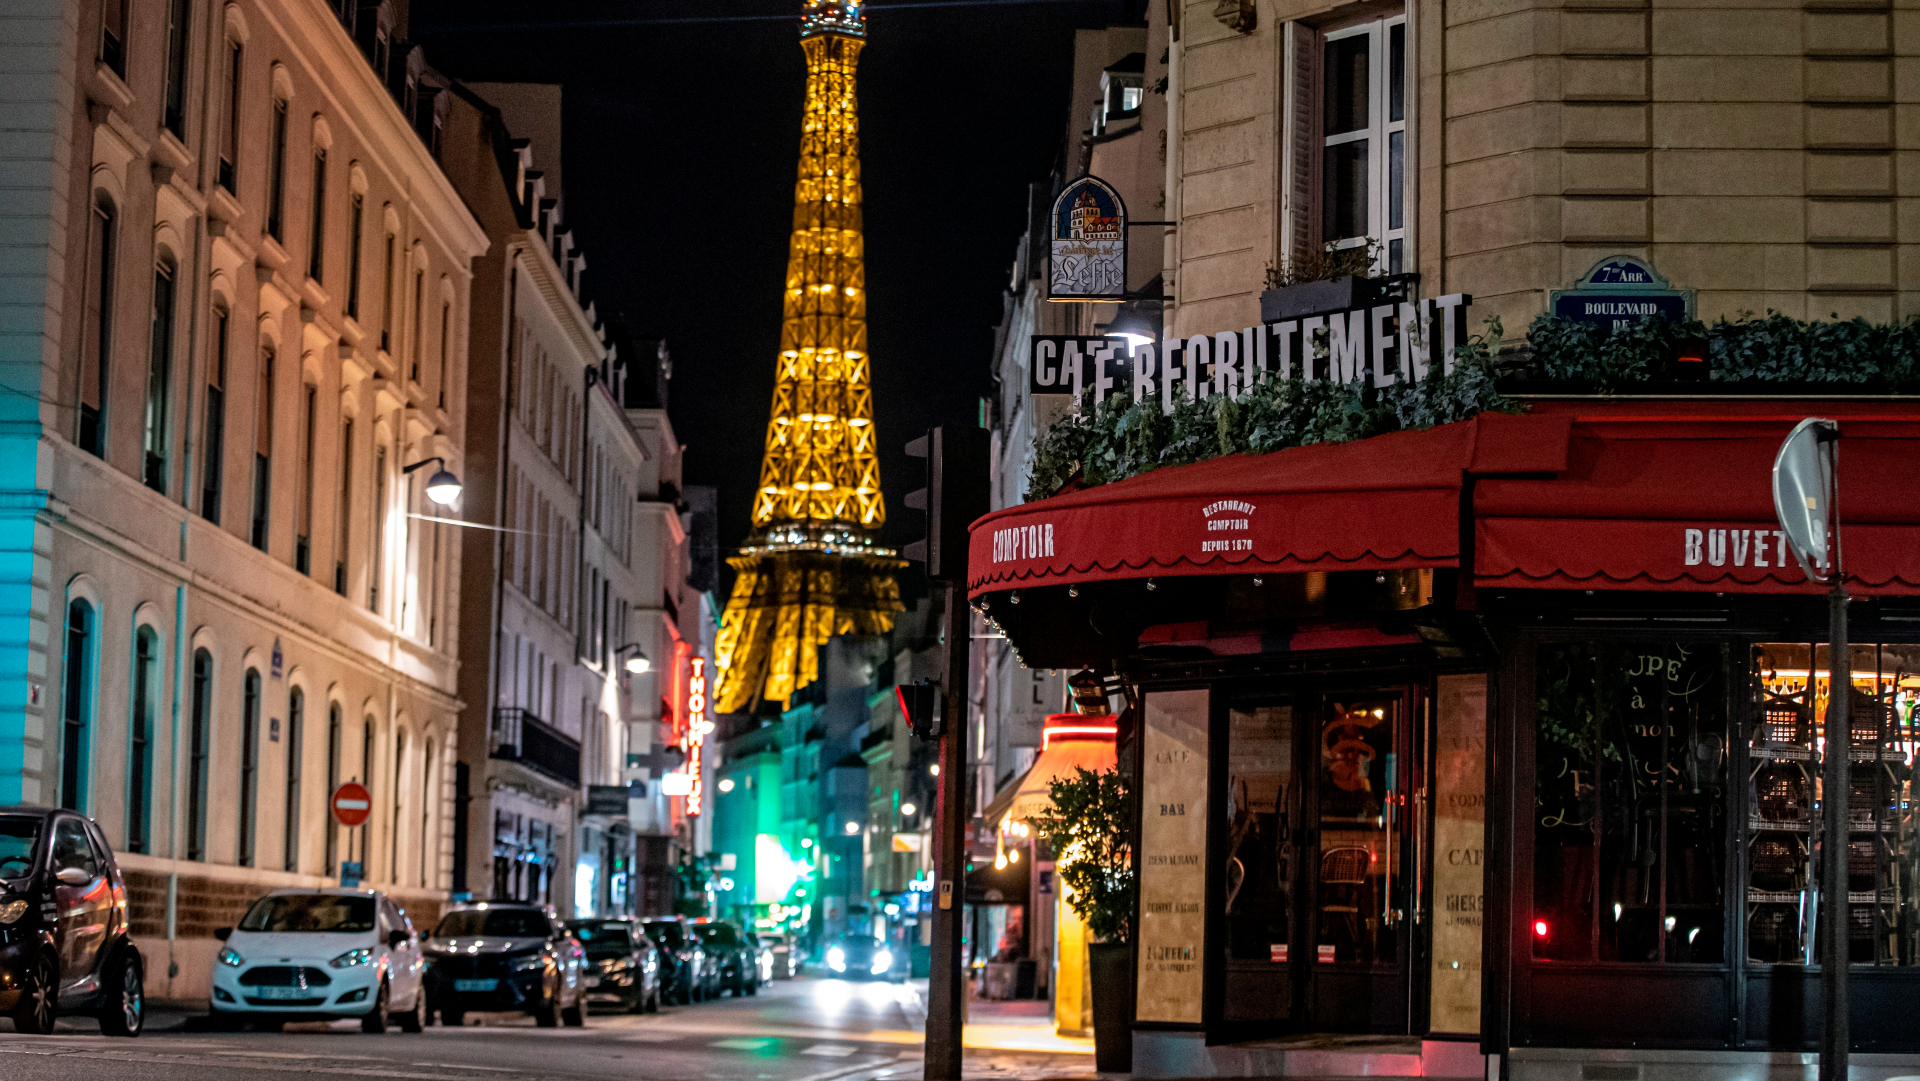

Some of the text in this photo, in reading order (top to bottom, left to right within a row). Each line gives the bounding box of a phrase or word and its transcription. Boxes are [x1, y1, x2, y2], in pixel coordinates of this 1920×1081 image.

[1052, 256, 1123, 294] Leffe
[1585, 303, 1657, 315] BOULEVARD
[1133, 293, 1462, 417] RECRUTEMENT
[1202, 500, 1257, 518] RESTAURANT
[1207, 519, 1249, 531] COMPTOIR
[993, 523, 1055, 564] COMPTOIR
[1202, 540, 1230, 552] DEPUIS
[1160, 803, 1186, 816] BAR
